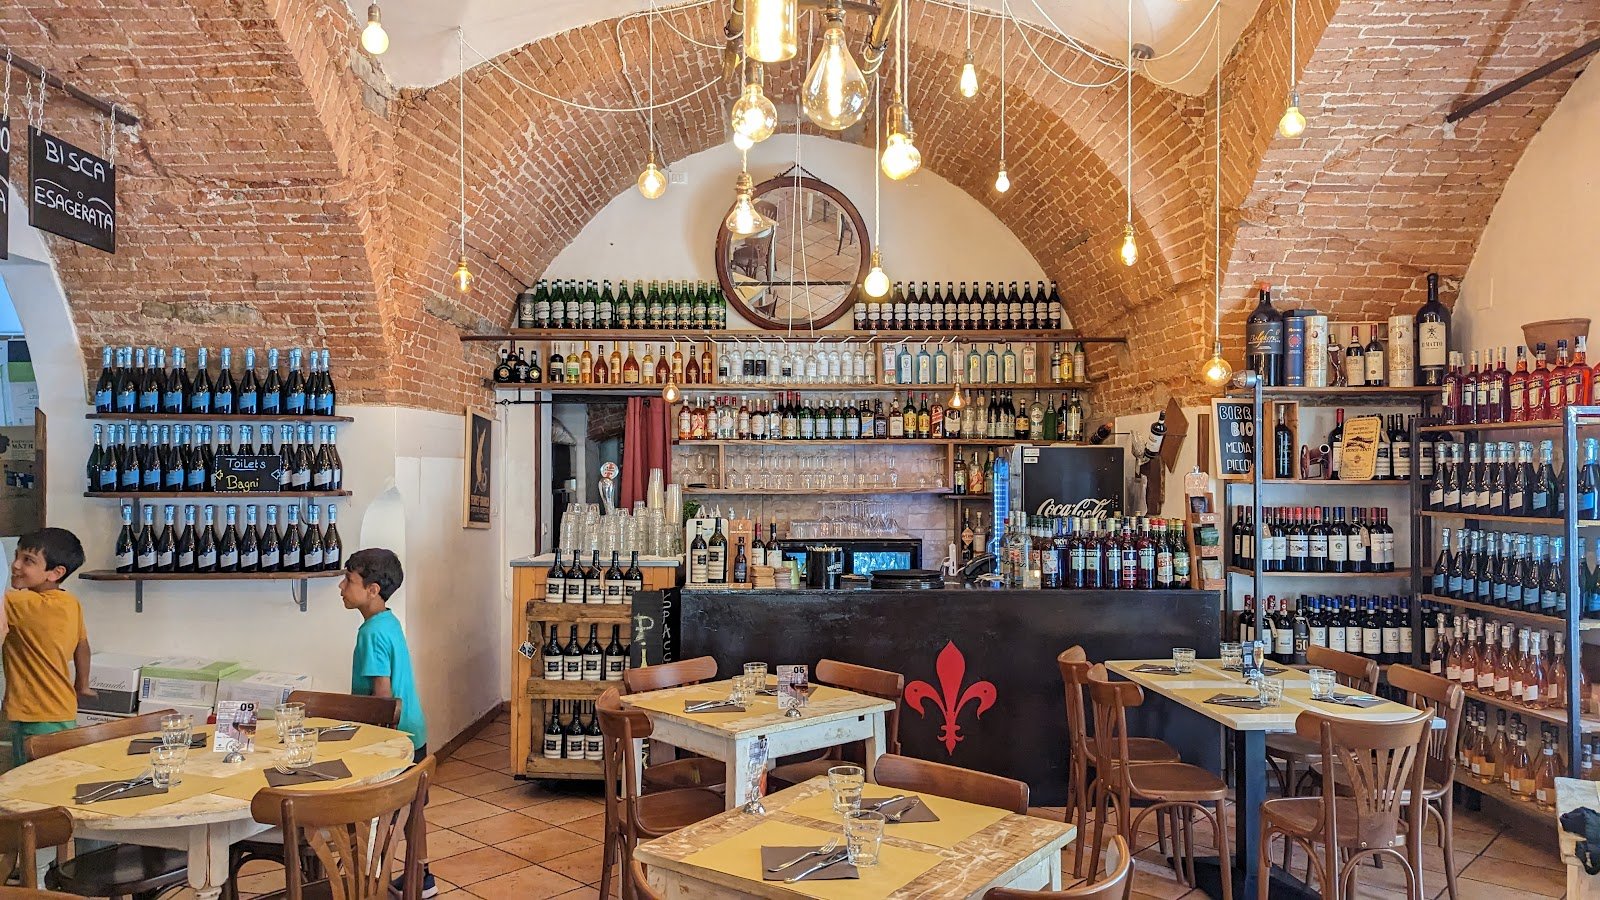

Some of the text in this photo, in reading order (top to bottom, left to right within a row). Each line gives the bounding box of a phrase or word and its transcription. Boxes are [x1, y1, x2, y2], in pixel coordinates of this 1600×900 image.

[45, 139, 105, 183] BISCA
[35, 185, 114, 233] ESAGERATA
[1219, 405, 1252, 420] BIRR
[1230, 421, 1254, 437] BIO
[225, 475, 259, 493] Bagni
[1296, 639, 1309, 651] 50
[793, 666, 805, 674] 06
[240, 703, 255, 712] 09
